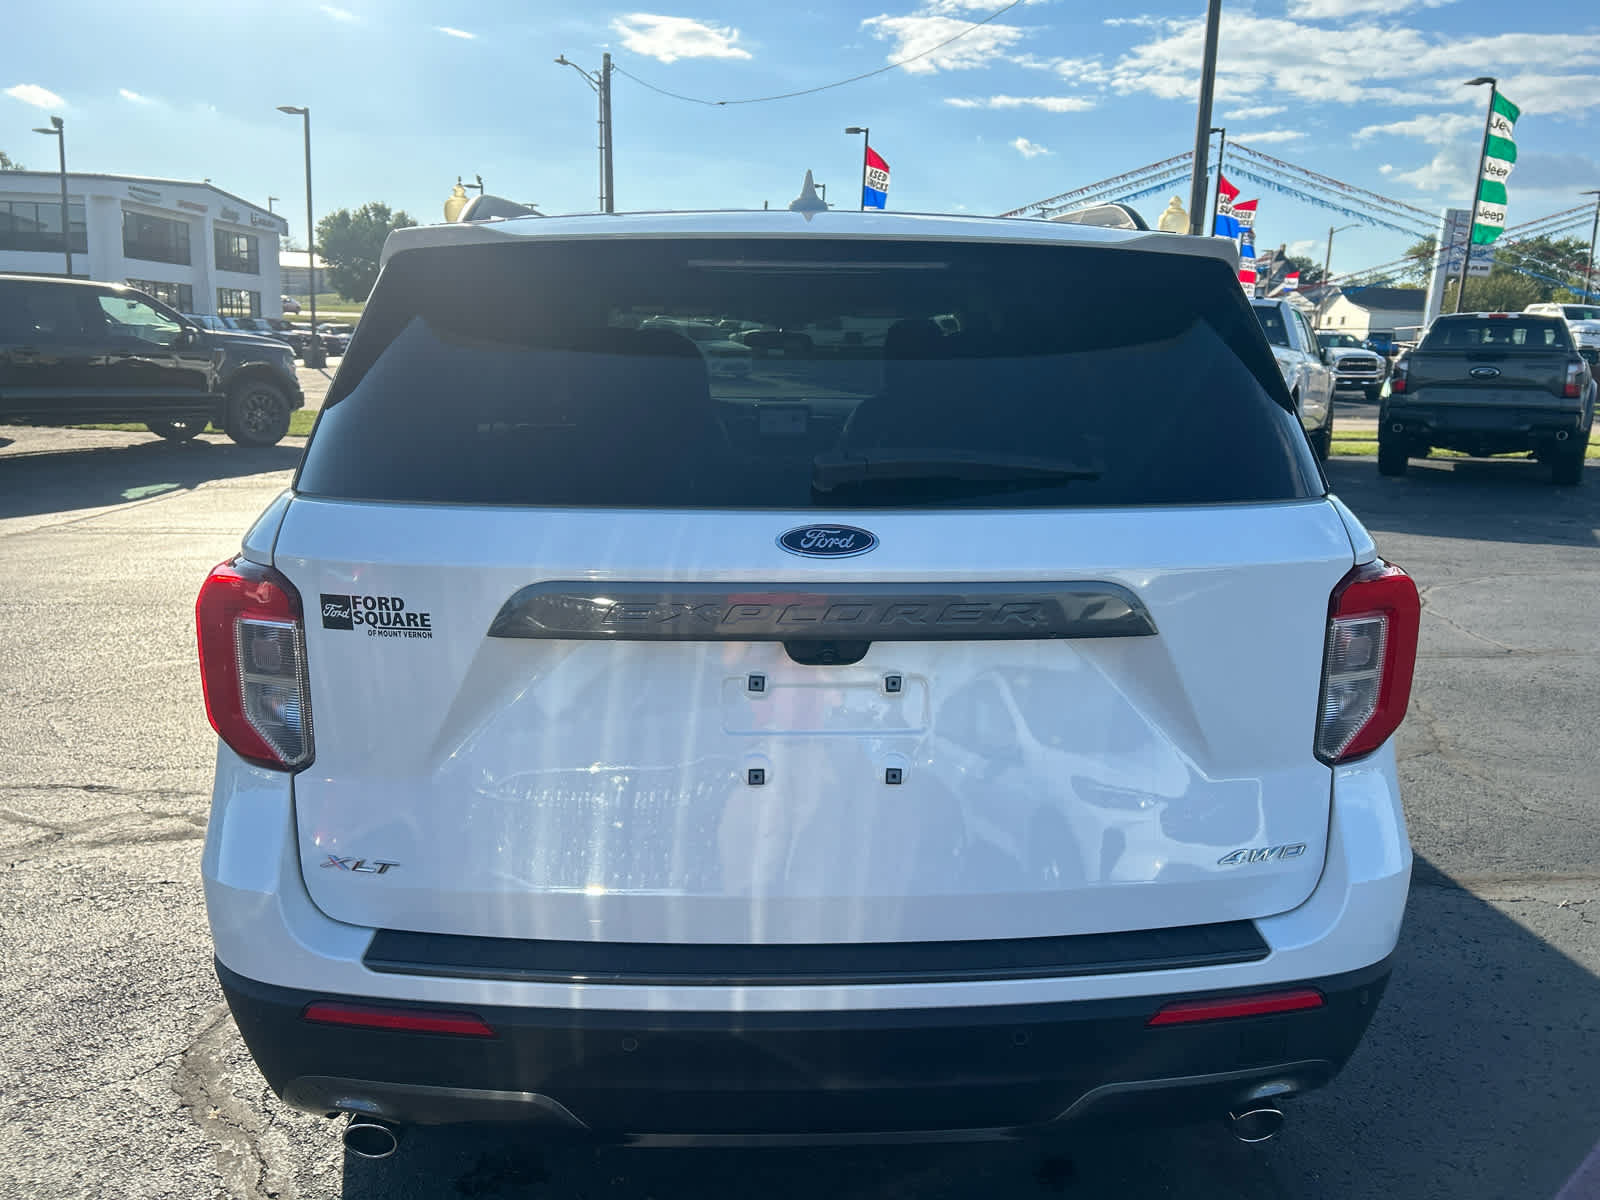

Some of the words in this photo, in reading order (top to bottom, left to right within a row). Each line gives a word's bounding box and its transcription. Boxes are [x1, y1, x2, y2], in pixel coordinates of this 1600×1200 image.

[1478, 207, 1505, 222] Jeep
[800, 529, 855, 549] Ford
[322, 603, 350, 619] Ford
[351, 595, 405, 612] FORD
[352, 611, 432, 629] SQUARE
[601, 602, 1048, 625] EXPLORER
[367, 629, 377, 637] OF
[378, 630, 402, 638] MOUNT
[403, 630, 433, 639] VERNON
[1217, 843, 1306, 865] 4WD
[320, 855, 400, 874] XLT
